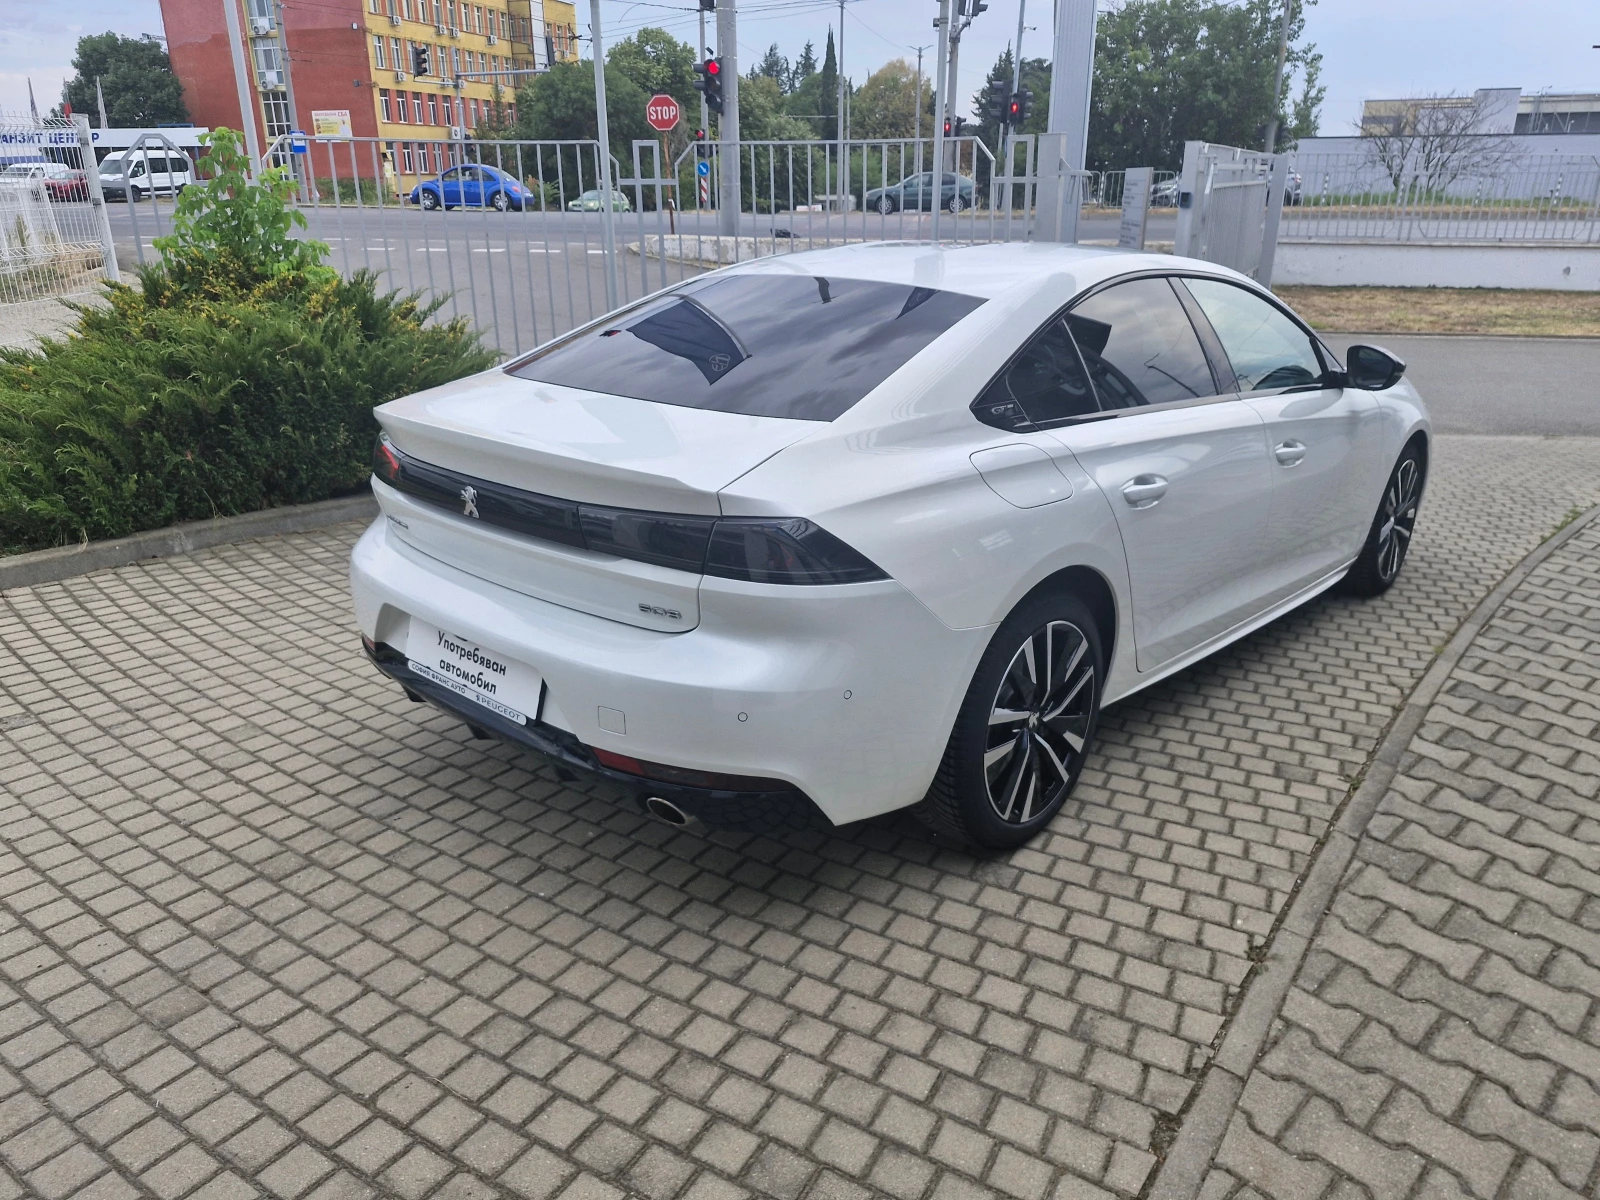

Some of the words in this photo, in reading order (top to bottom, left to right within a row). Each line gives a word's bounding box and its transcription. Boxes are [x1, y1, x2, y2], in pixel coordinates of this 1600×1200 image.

[650, 106, 676, 120] STOP
[0, 132, 43, 144] АНЗИТ
[638, 603, 683, 619] 508
[438, 631, 507, 676] Употребяван
[440, 659, 497, 695] автомобил
[411, 663, 430, 677] СОФИЯ
[431, 672, 450, 687] ФРАНС
[450, 681, 466, 694] АУТО
[481, 697, 521, 721] PEUGEOT
